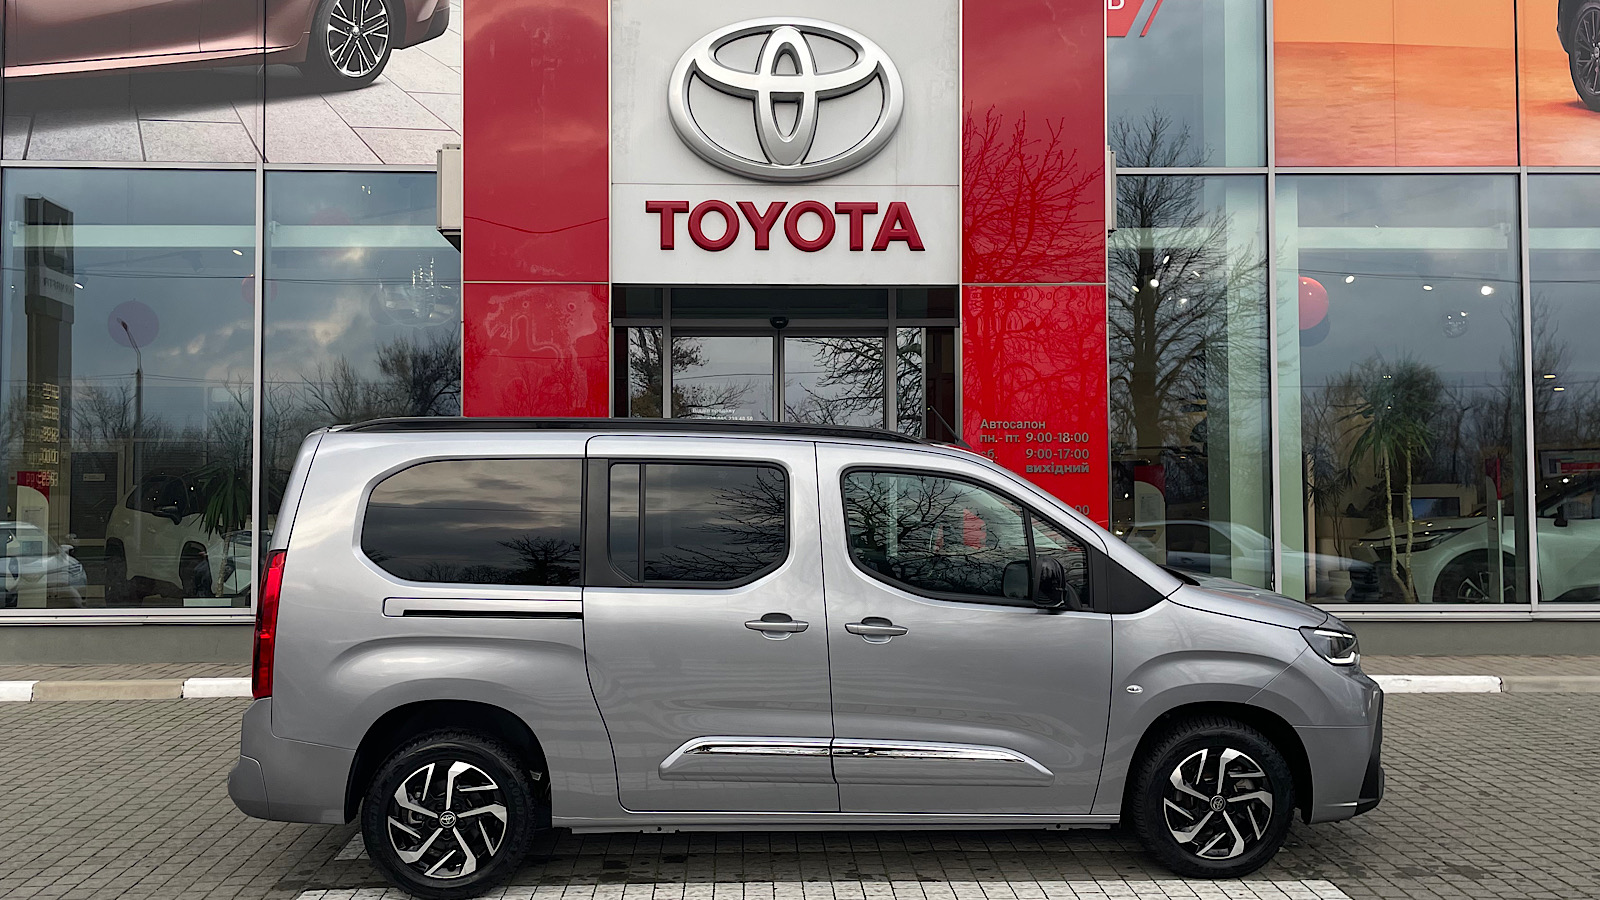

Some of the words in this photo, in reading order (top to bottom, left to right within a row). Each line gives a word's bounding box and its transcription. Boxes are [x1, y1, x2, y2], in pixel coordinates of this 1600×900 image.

[646, 200, 925, 252] TOYOTA
[980, 419, 1046, 429] Автосалон
[1005, 434, 1020, 443] пт.
[1025, 432, 1089, 443] 9:00-18:00
[1025, 448, 1090, 459] 9:00-17:00
[1026, 462, 1090, 474] вихідний
